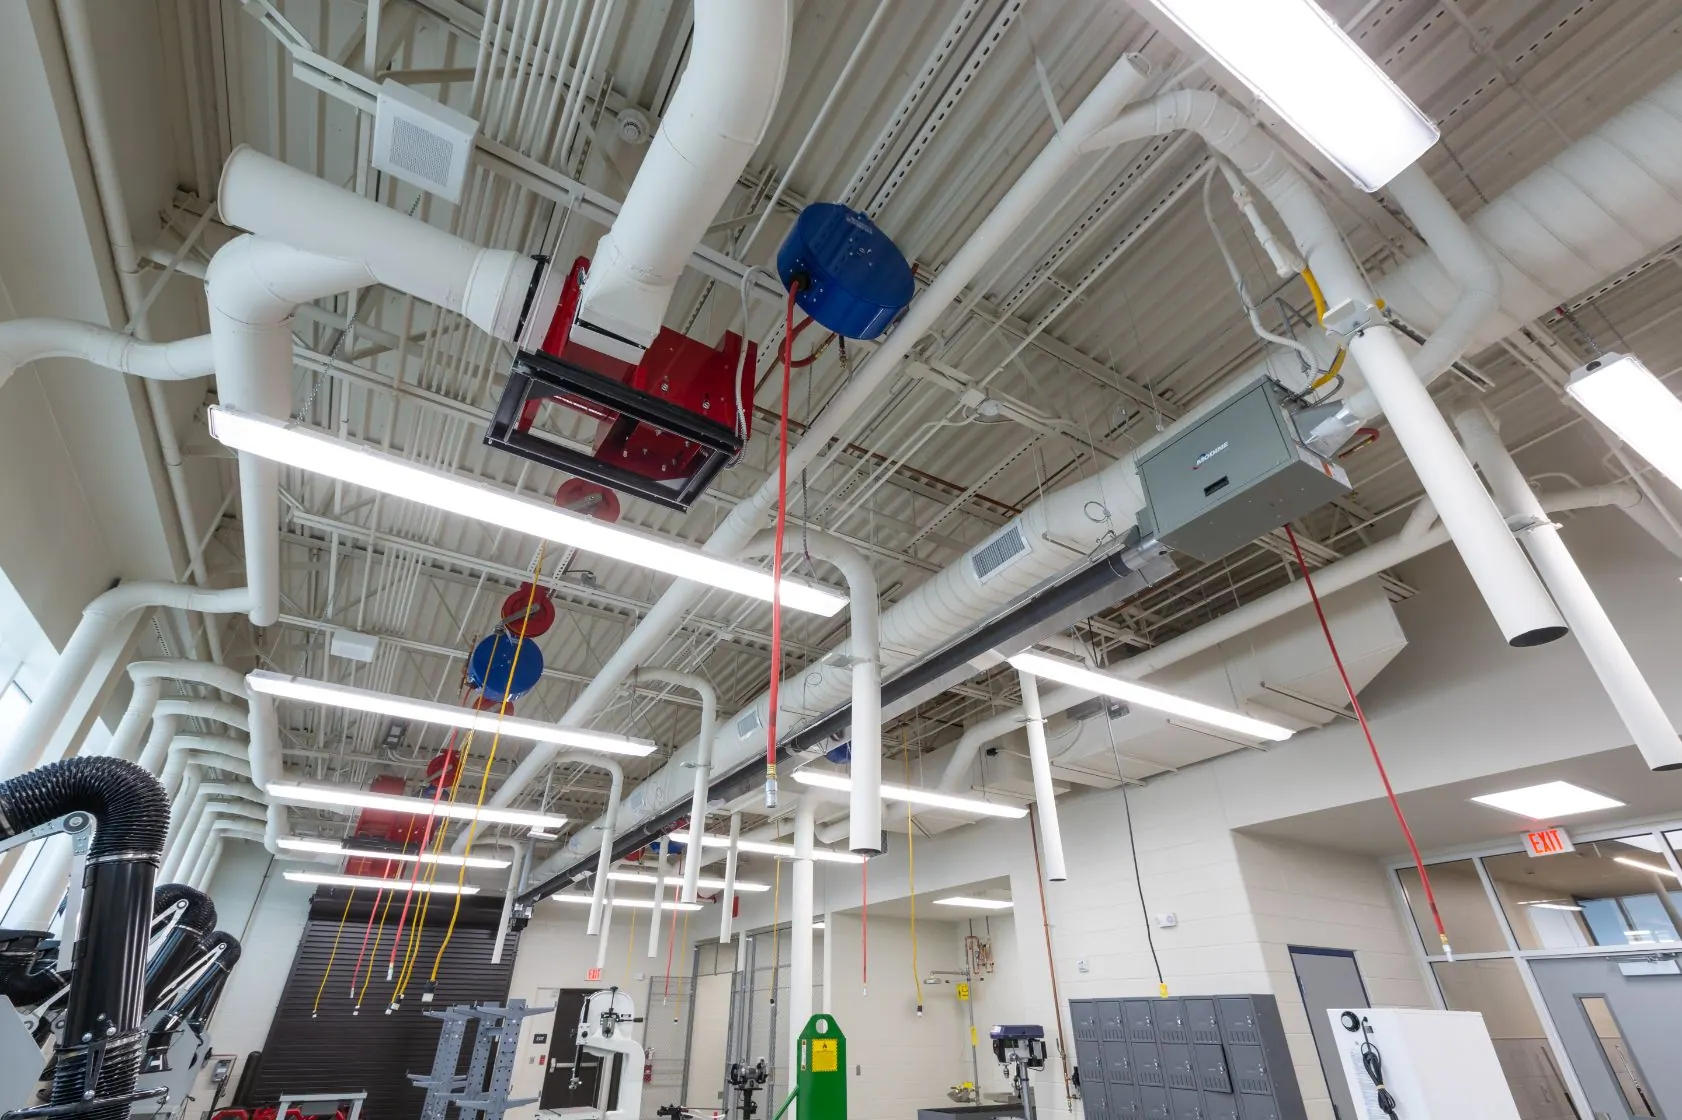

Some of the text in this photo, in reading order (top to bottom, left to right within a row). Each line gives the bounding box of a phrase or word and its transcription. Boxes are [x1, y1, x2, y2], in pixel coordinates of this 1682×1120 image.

[1196, 441, 1229, 466] MODINE
[1528, 829, 1564, 855] EXIT
[588, 968, 601, 980] EXIT
